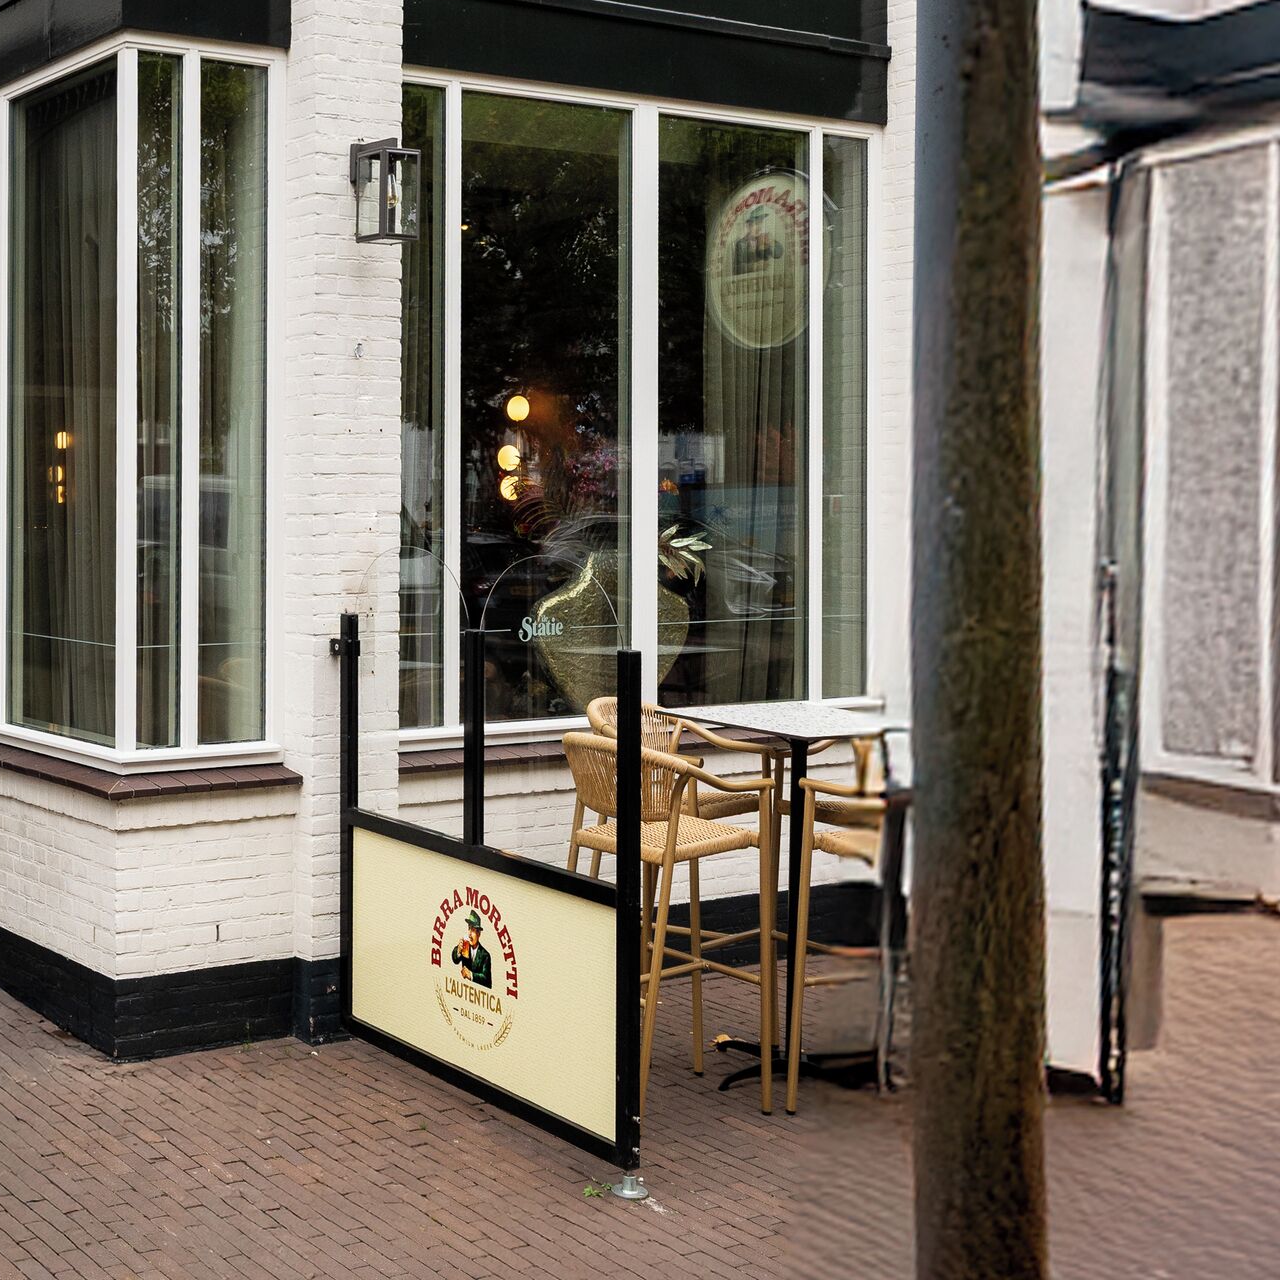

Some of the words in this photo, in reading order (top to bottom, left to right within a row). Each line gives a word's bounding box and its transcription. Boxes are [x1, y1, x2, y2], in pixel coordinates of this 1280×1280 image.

[518, 616, 564, 642] Statie
[431, 889, 464, 968] BIRRA
[465, 886, 518, 1000] MORETTI
[445, 976, 502, 1015] L'AUTENTICA
[460, 1007, 471, 1020] DAL
[472, 1012, 486, 1025] 1859
